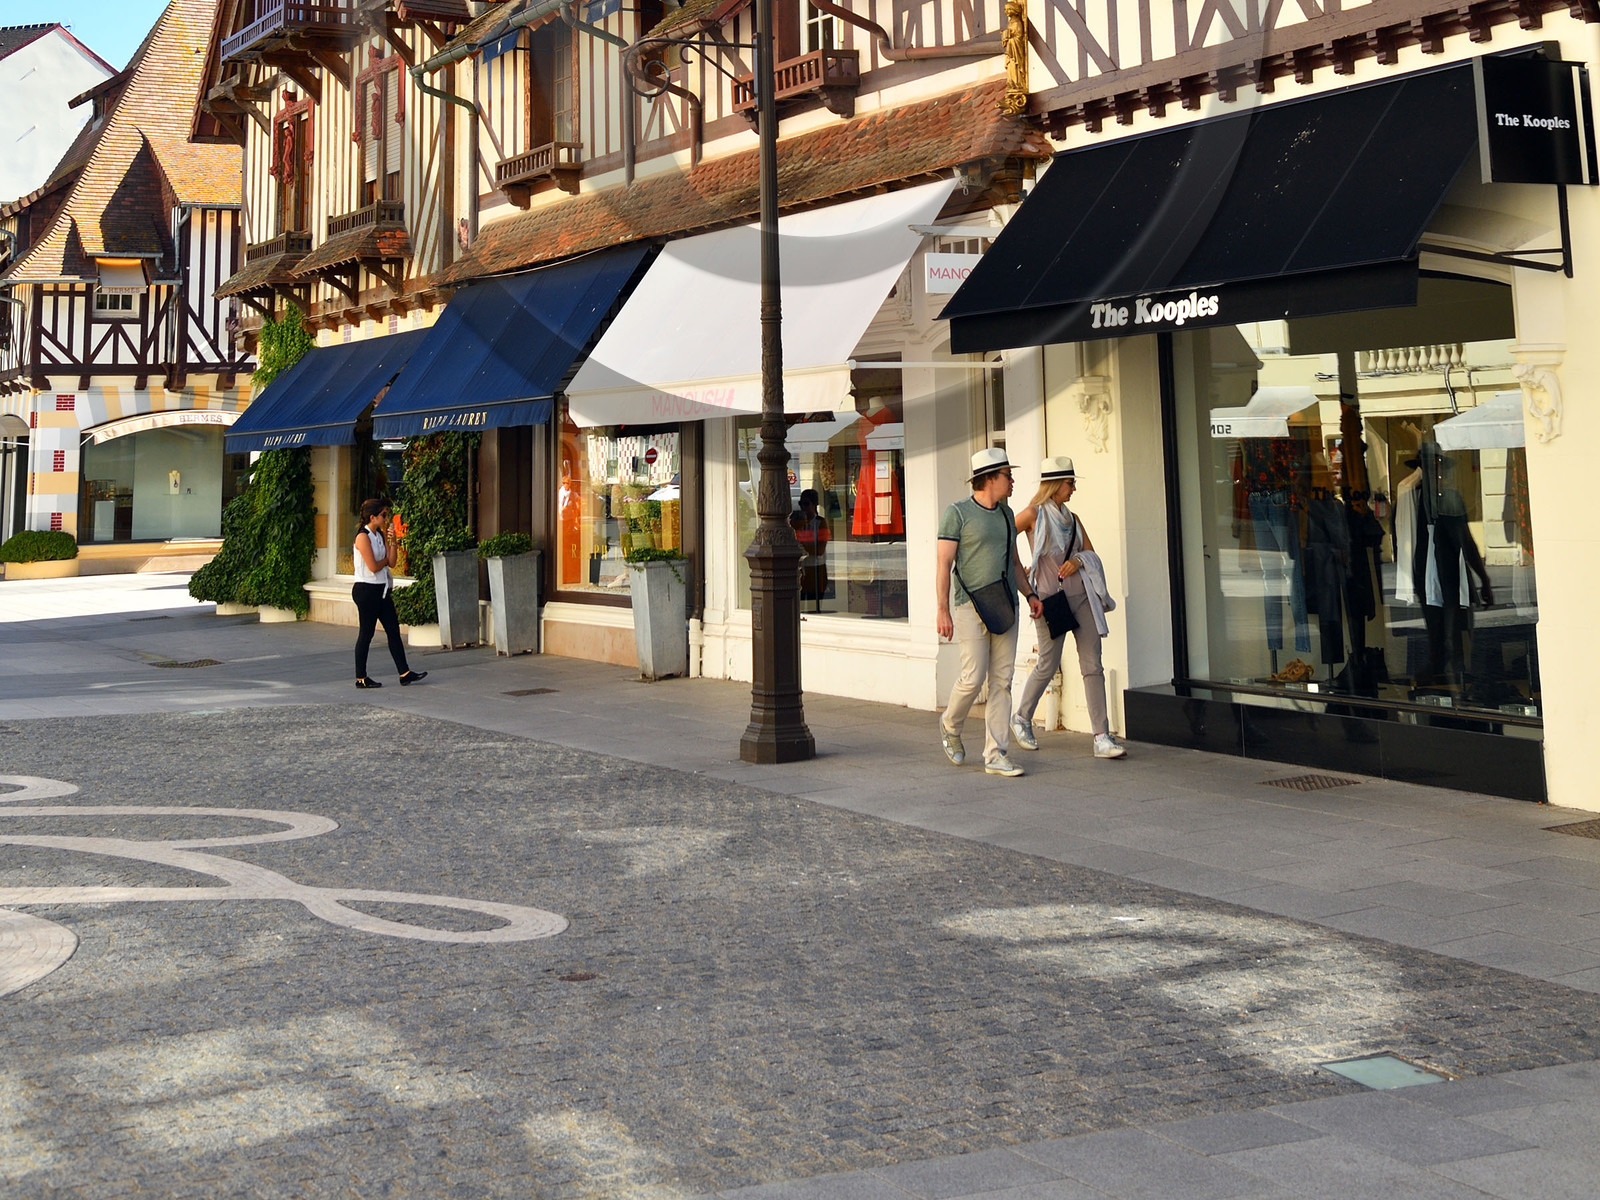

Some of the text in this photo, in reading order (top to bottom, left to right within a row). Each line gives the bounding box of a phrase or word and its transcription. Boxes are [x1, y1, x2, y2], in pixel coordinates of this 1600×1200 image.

[1495, 113, 1571, 131] The Kooples
[1090, 291, 1219, 329] The Kooples
[651, 387, 727, 417] MANOUSH
[179, 414, 223, 423] HERMES
[423, 411, 488, 430] RALPH LAUREN
